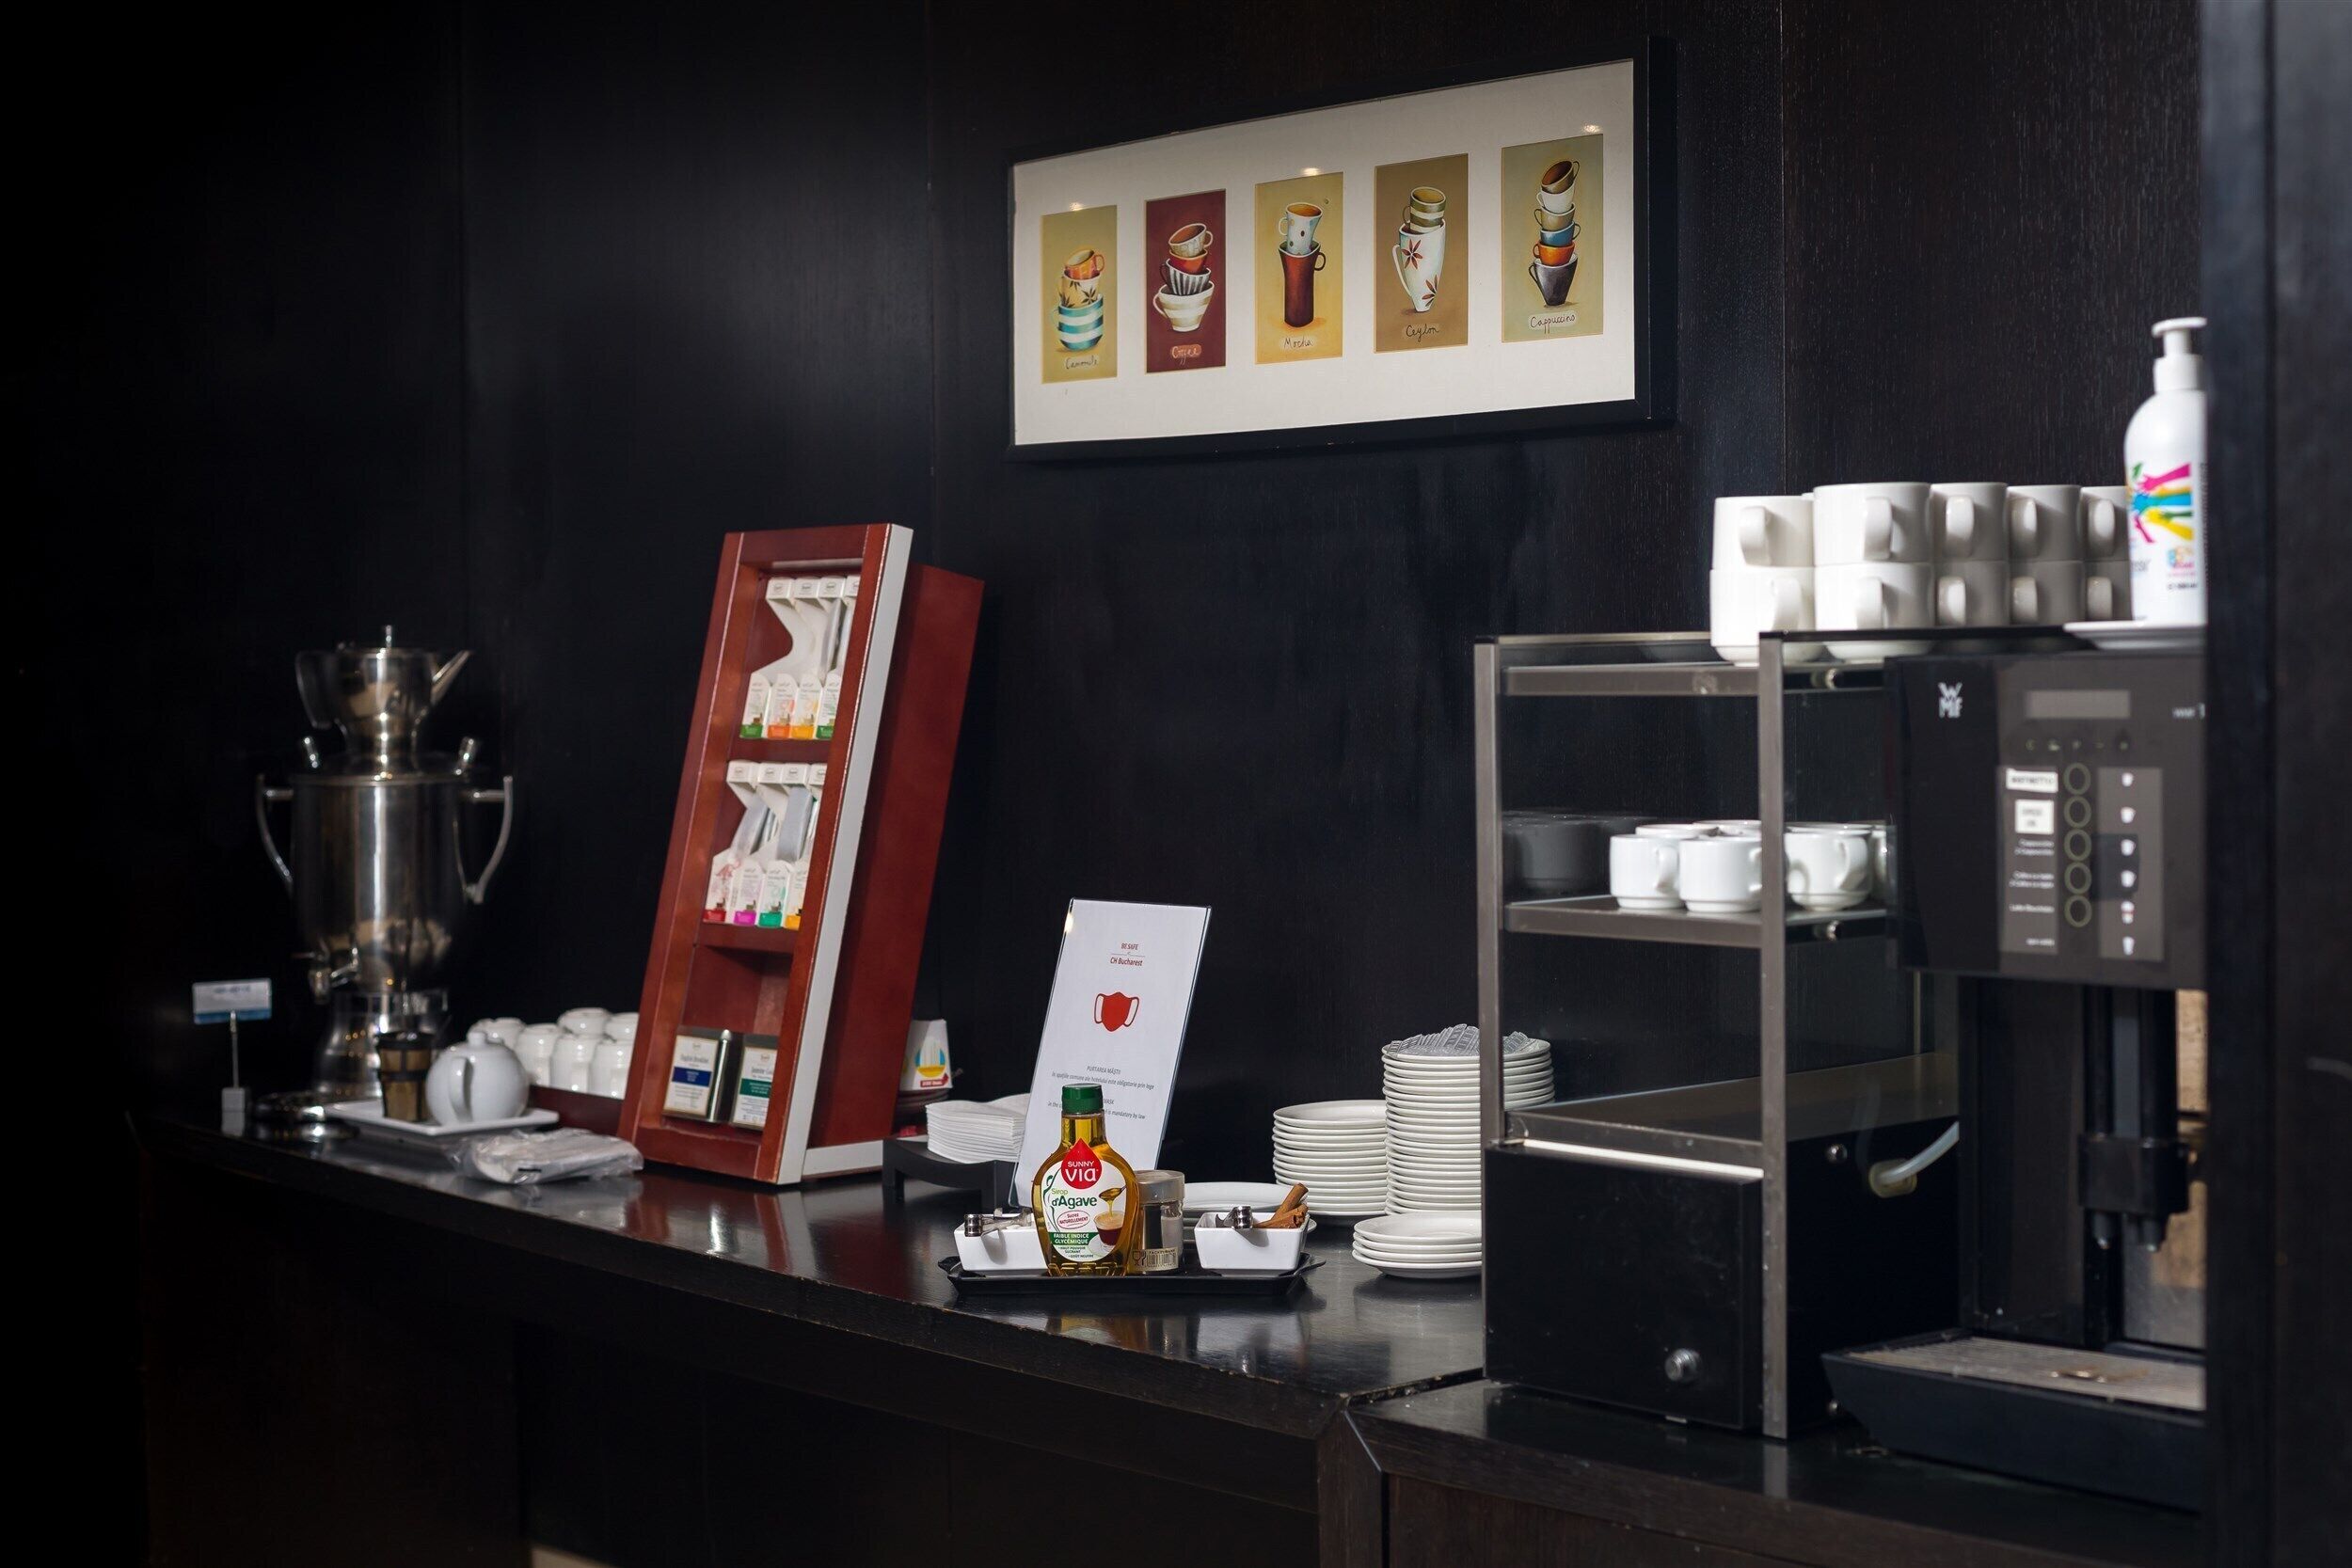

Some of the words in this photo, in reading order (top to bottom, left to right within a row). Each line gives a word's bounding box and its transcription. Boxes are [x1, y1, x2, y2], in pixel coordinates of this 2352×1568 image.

[1530, 314, 1576, 334] Cappuccino
[1405, 324, 1439, 342] Ceylon
[1283, 336, 1313, 348] Mocha
[1171, 345, 1200, 365] Coffee
[1118, 958, 1143, 967] Bucharest
[1067, 1160, 1094, 1168] SUNNY
[1051, 1196, 1098, 1210] d'Agave
